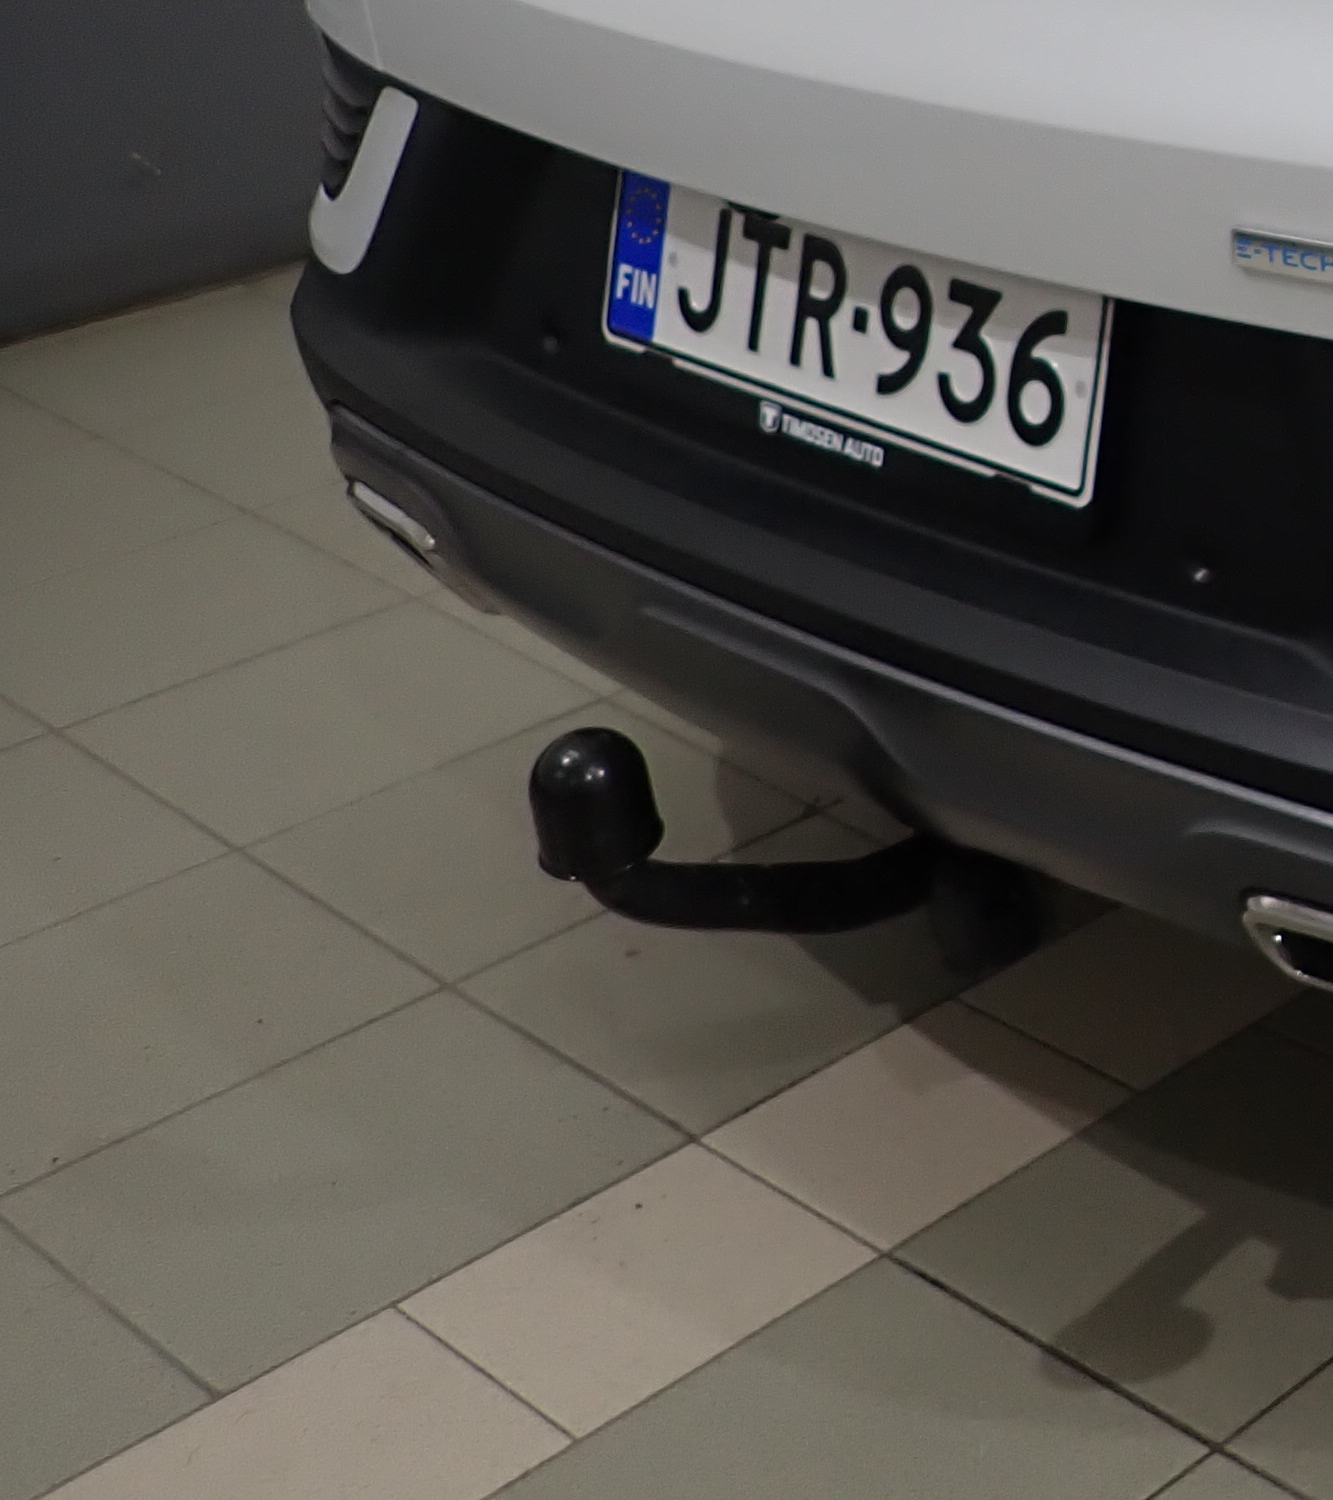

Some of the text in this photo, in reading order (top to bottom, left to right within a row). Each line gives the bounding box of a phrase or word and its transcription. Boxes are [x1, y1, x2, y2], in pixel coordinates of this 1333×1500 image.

[616, 263, 657, 310] FIN
[677, 208, 1068, 447] JTR-936
[843, 437, 885, 468] AUTO
